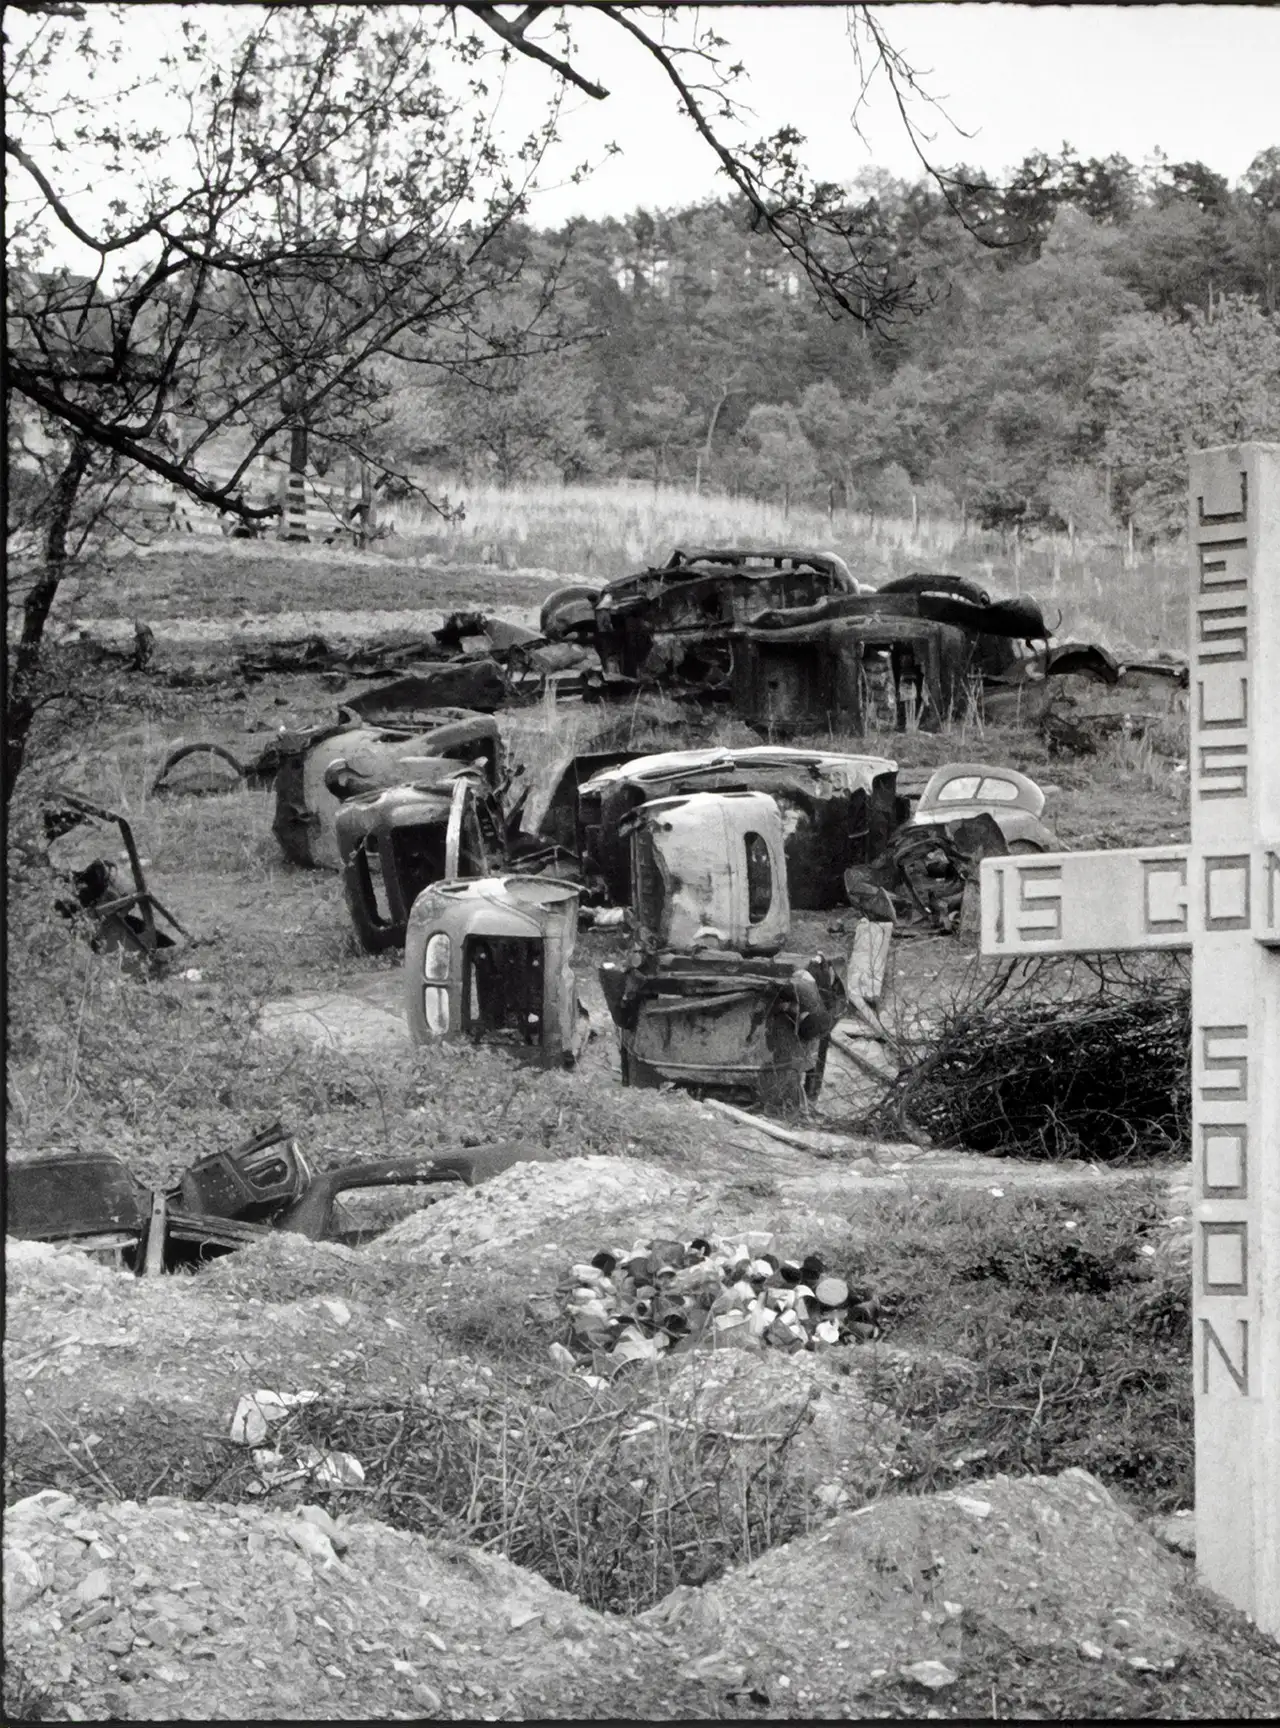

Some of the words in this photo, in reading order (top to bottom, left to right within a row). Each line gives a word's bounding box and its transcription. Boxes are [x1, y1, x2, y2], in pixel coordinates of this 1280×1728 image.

[1197, 471, 1248, 799] JESUS
[996, 865, 1062, 943] IS
[1199, 1025, 1249, 1396] SOON
